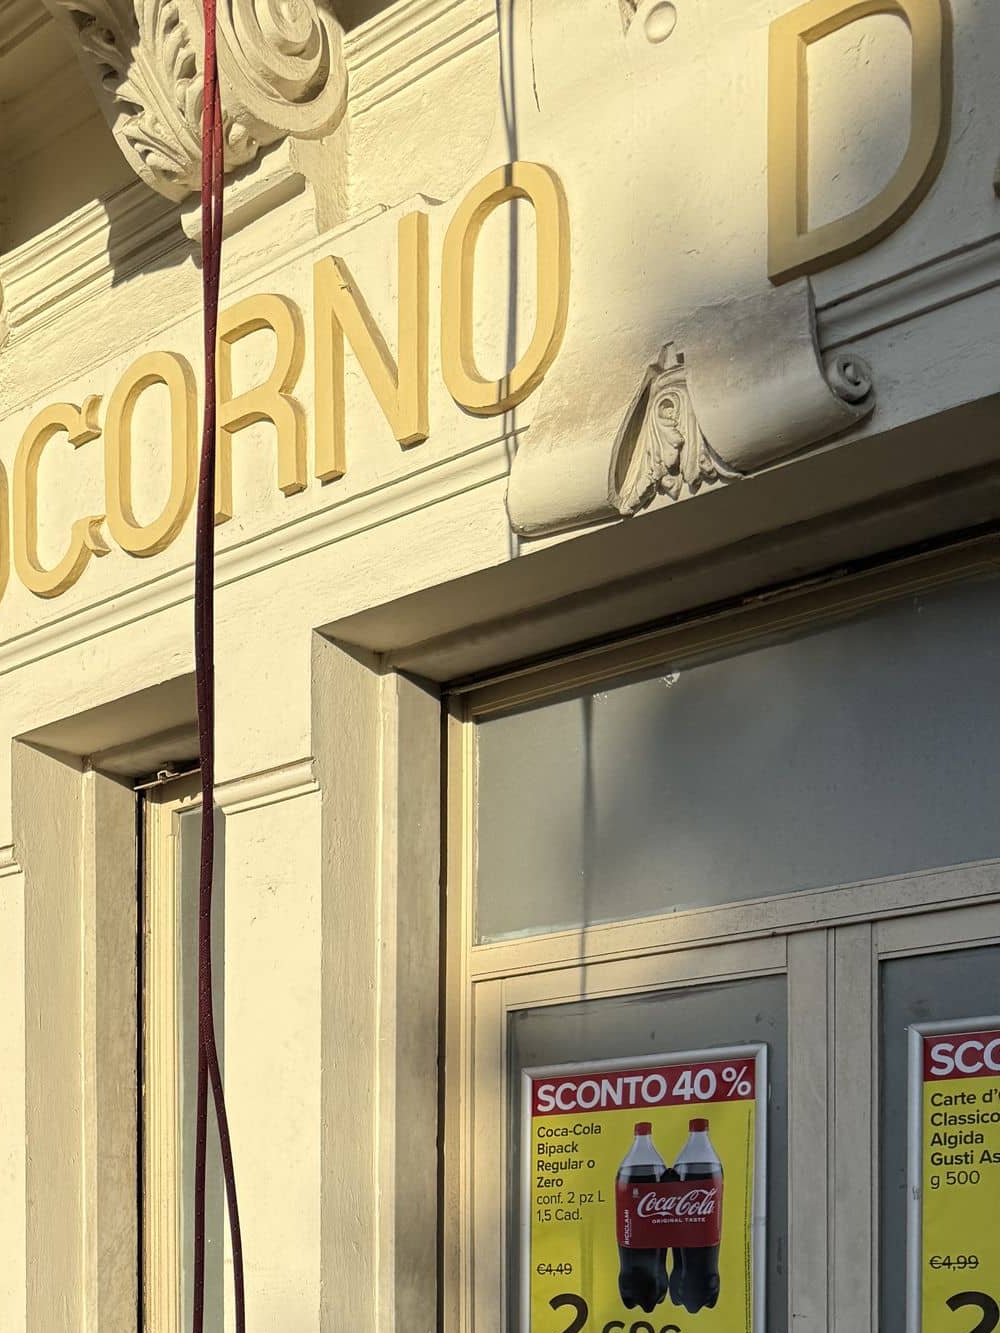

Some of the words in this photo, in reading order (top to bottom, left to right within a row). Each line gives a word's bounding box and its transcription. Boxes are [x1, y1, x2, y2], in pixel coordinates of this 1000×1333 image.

[537, 1074, 667, 1112] SCONTO
[930, 1091, 977, 1107] Carte
[982, 1088, 1000, 1104] d'
[930, 1109, 1000, 1127] Classico
[537, 1123, 601, 1138] Coca-Cola
[930, 1130, 984, 1149] Algida
[537, 1141, 579, 1157] Bipack
[536, 1159, 584, 1174] Regular
[587, 1159, 595, 1169] o
[930, 1151, 974, 1166] Gusti
[536, 1177, 563, 1188] Zero
[930, 1175, 940, 1189] g
[946, 1170, 980, 1185] 500
[536, 1192, 564, 1204] conf.
[567, 1192, 575, 1204] 2
[579, 1192, 594, 1207] pz
[597, 1191, 605, 1203] L
[637, 1188, 717, 1218] Coca-Cola
[536, 1209, 552, 1222] 1,5
[555, 1208, 583, 1221] Cad.
[536, 1263, 573, 1277] €4,49
[929, 1255, 979, 1272] €4,99
